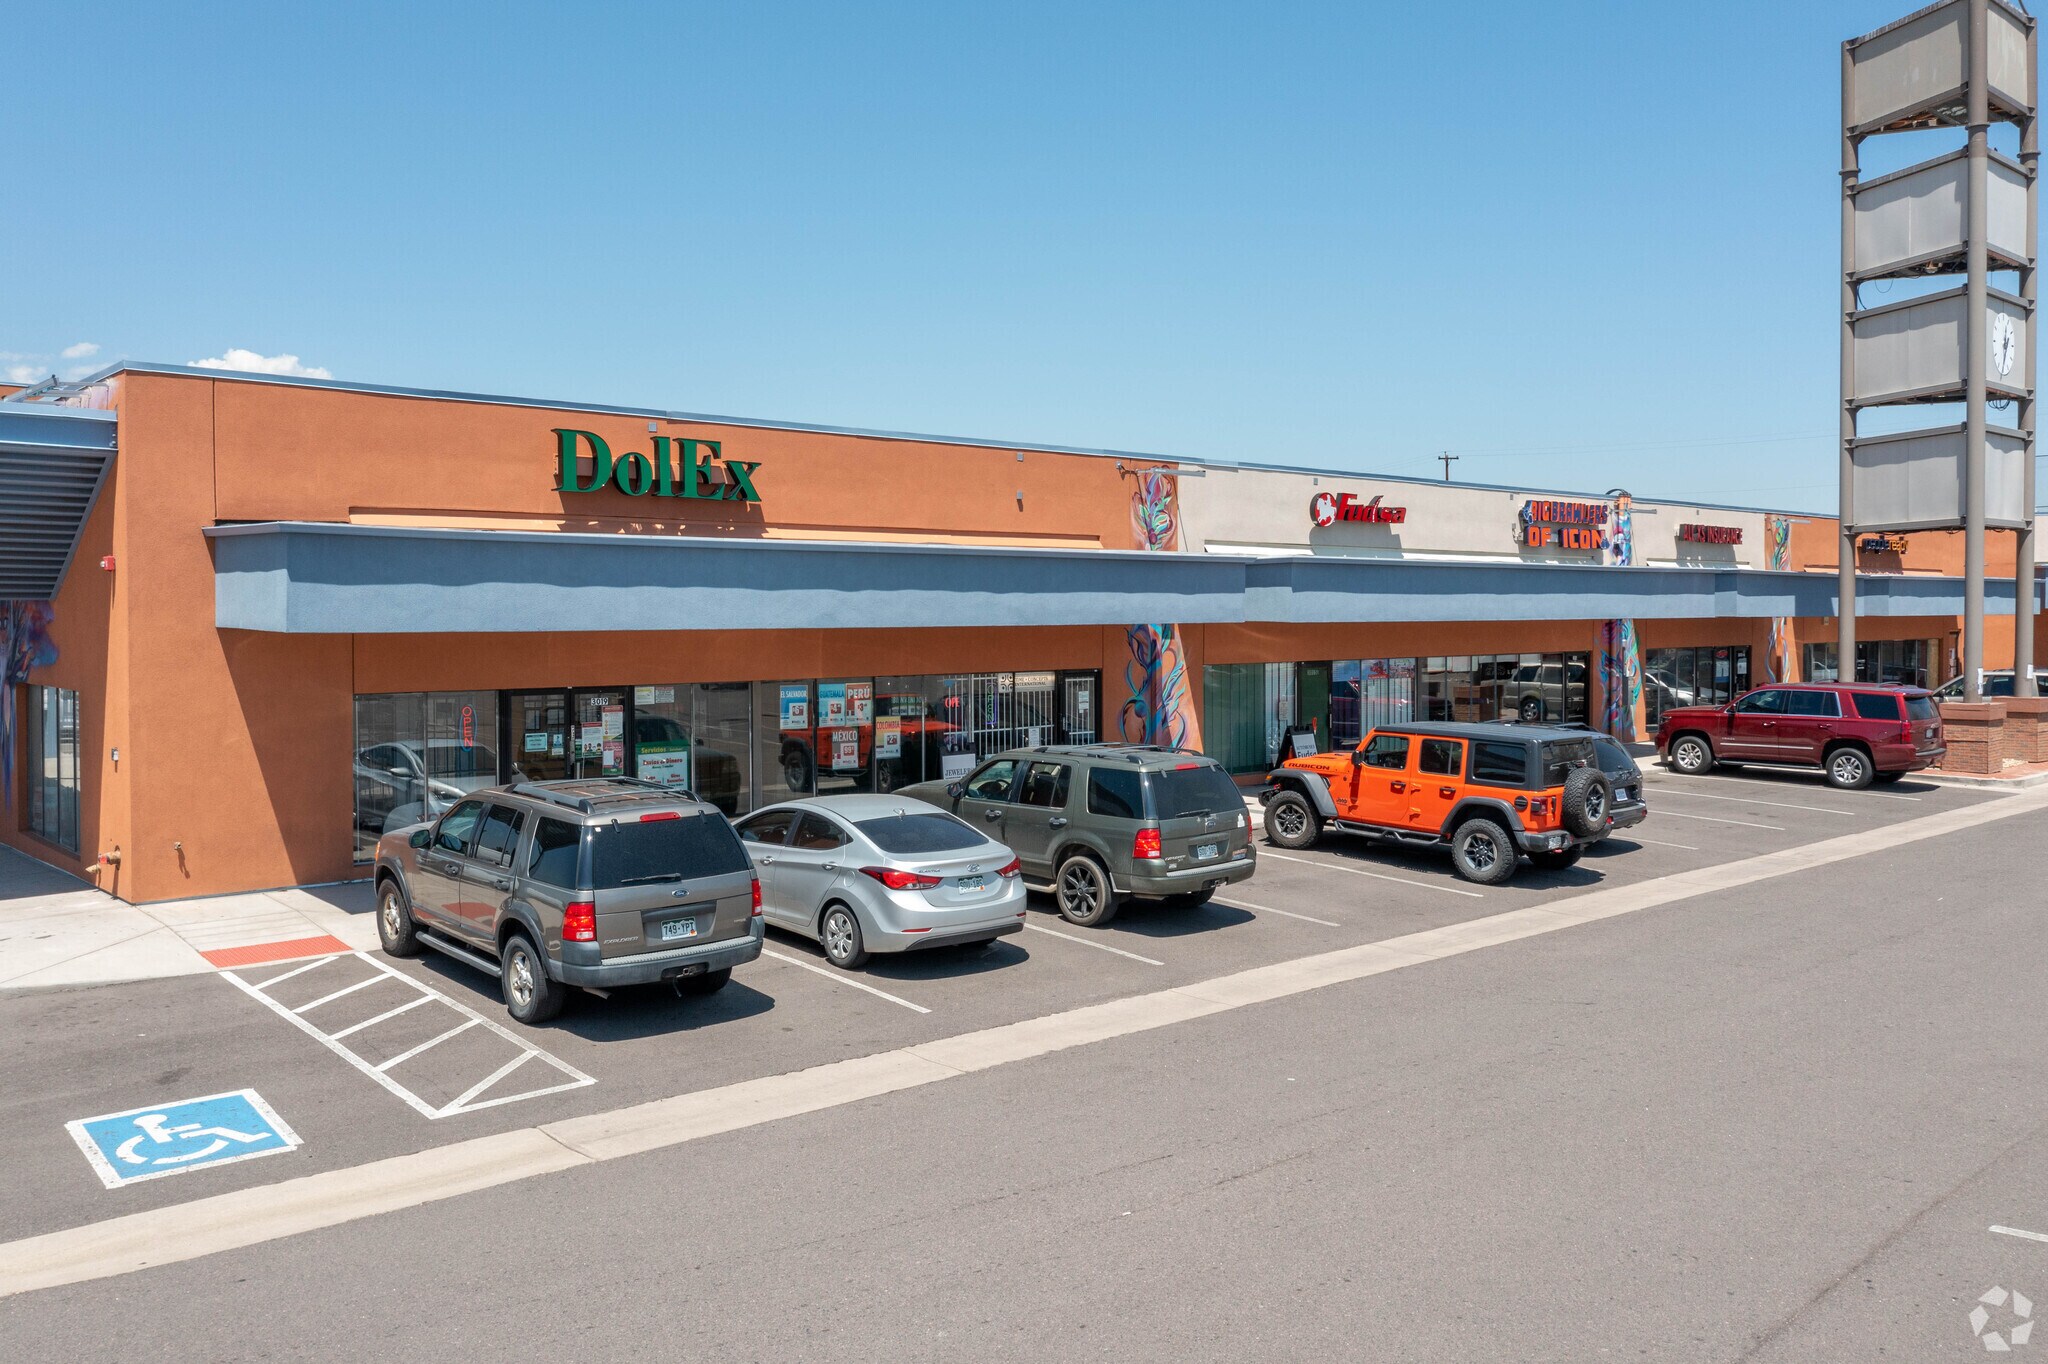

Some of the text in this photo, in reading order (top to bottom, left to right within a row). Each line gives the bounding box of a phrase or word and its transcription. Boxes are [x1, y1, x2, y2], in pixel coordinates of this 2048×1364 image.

[551, 428, 762, 502] DolEx
[1336, 492, 1407, 524] Fudsa
[1551, 501, 1609, 525] BRAWLERS
[1525, 526, 1606, 550] OF ICON
[780, 690, 807, 698] EL SALVADOR
[820, 690, 845, 698] GUATEMALA
[848, 686, 870, 699] PERÚ
[461, 706, 473, 747] OPEN
[832, 729, 858, 742] MÉXICO
[1288, 762, 1330, 770] RUBICON
[664, 921, 694, 936] 749-YPT
